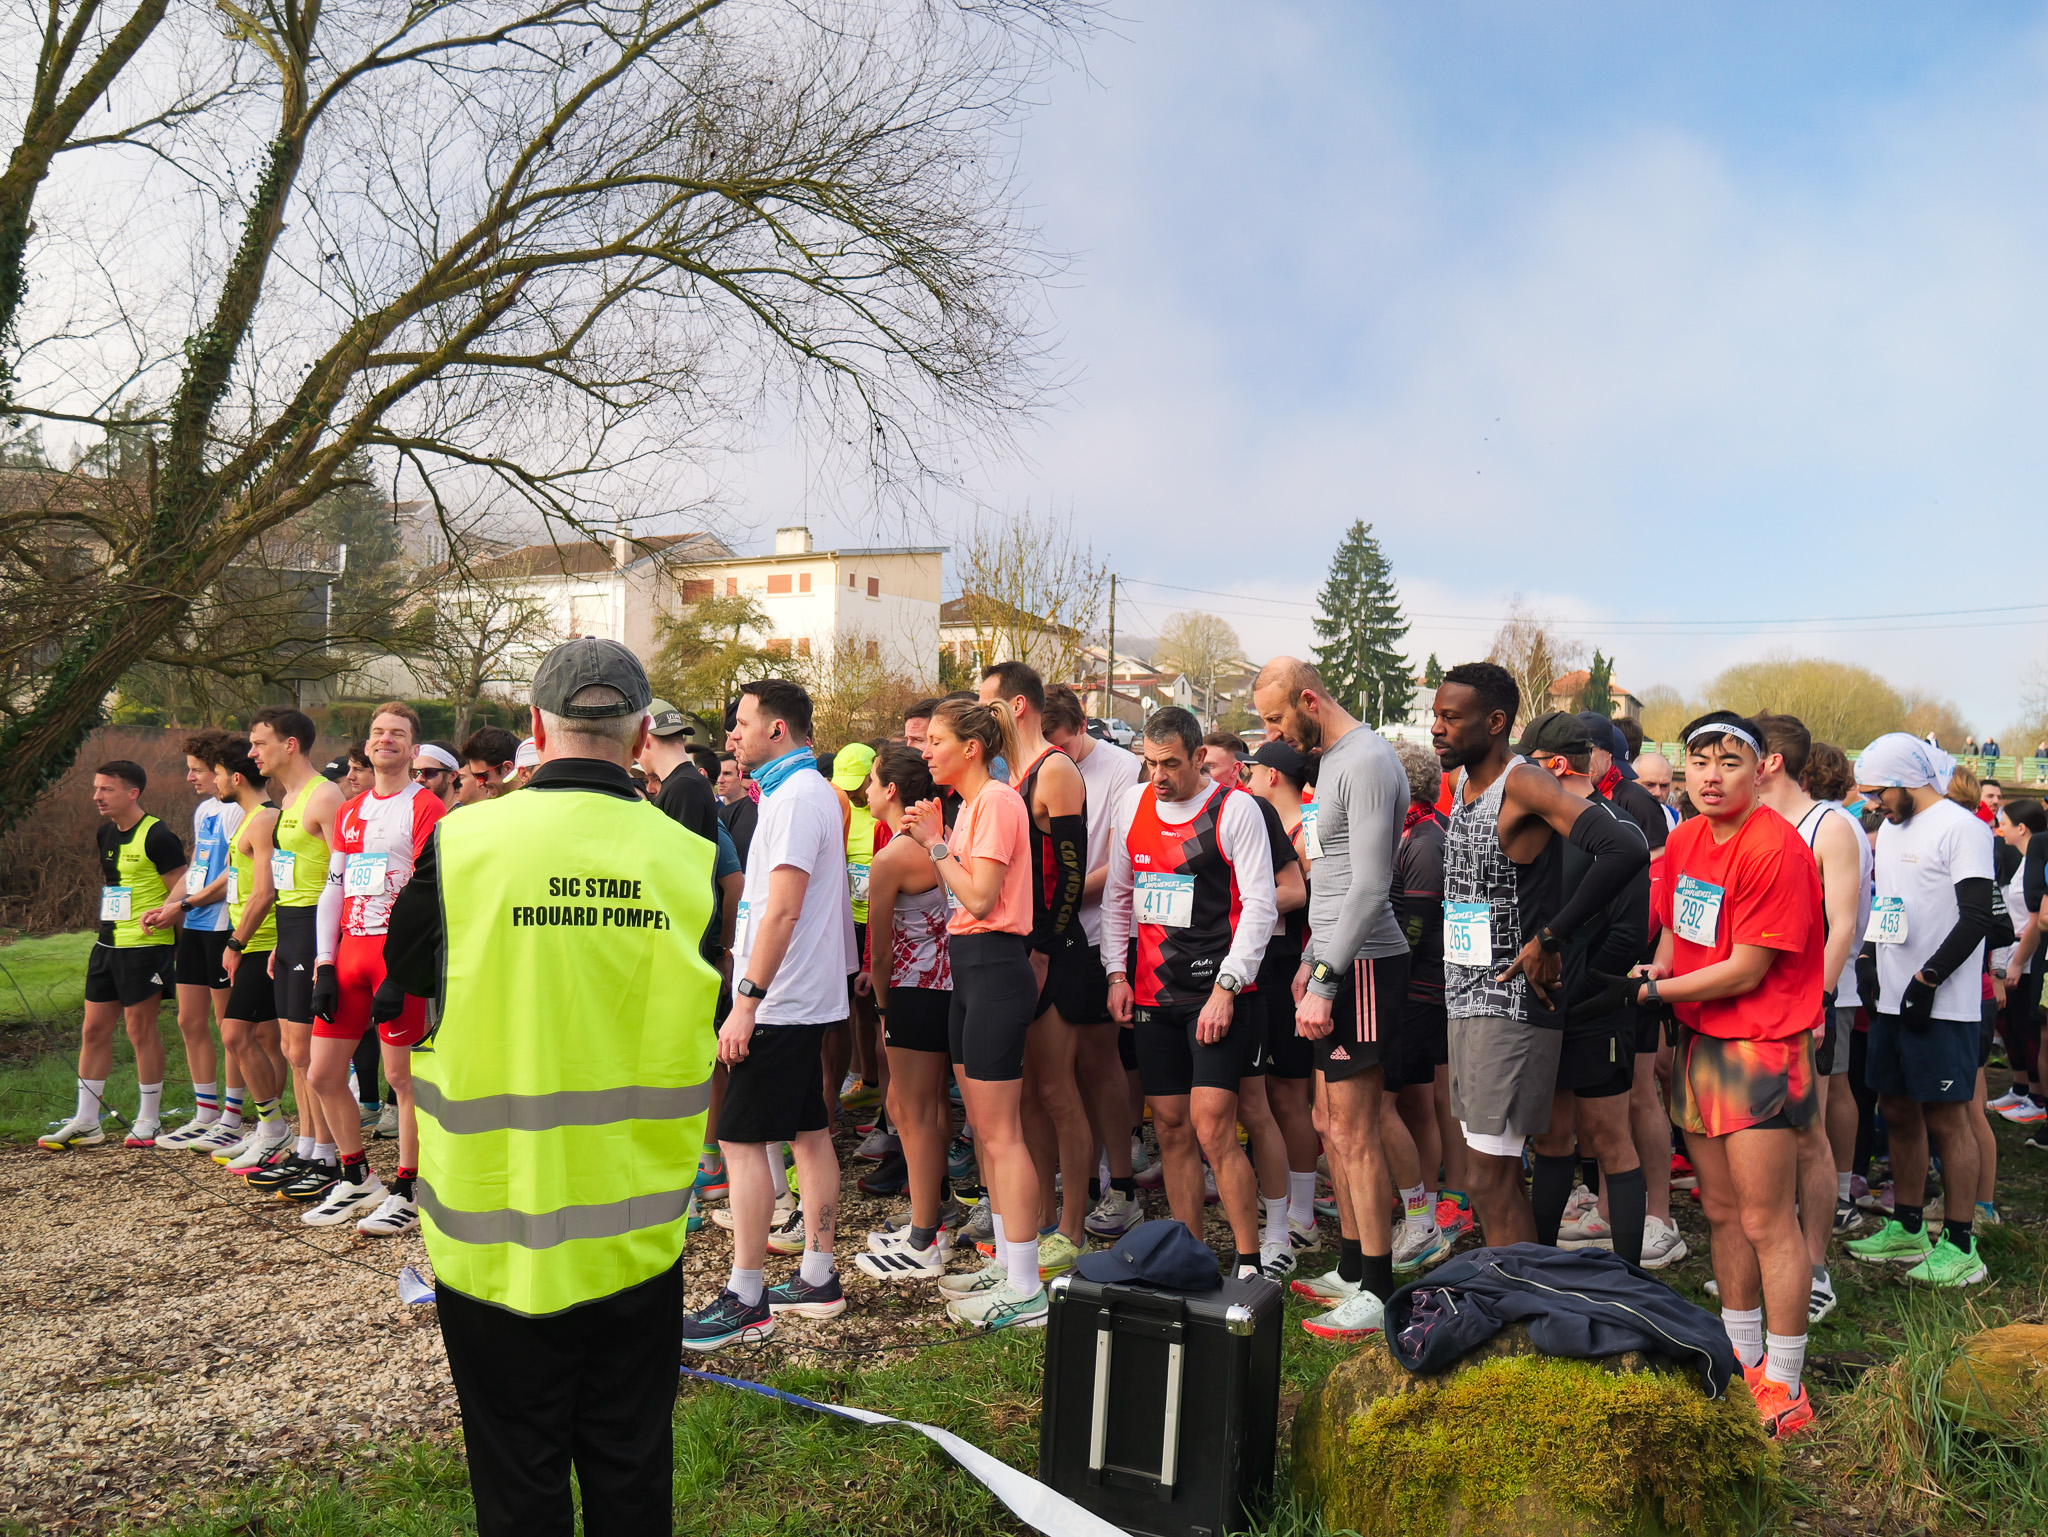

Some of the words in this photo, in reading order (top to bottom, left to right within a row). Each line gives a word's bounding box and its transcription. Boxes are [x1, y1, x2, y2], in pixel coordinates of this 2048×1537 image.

[350, 867, 372, 887] 489
[549, 877, 581, 898] SIC
[585, 878, 642, 900] STADE
[1144, 890, 1173, 914] 411
[513, 906, 598, 927] FROUARD
[1680, 898, 1705, 930] 292
[1880, 913, 1900, 933] 453
[1448, 923, 1472, 951] 265
[1441, 1222, 1462, 1234] ROOKS
